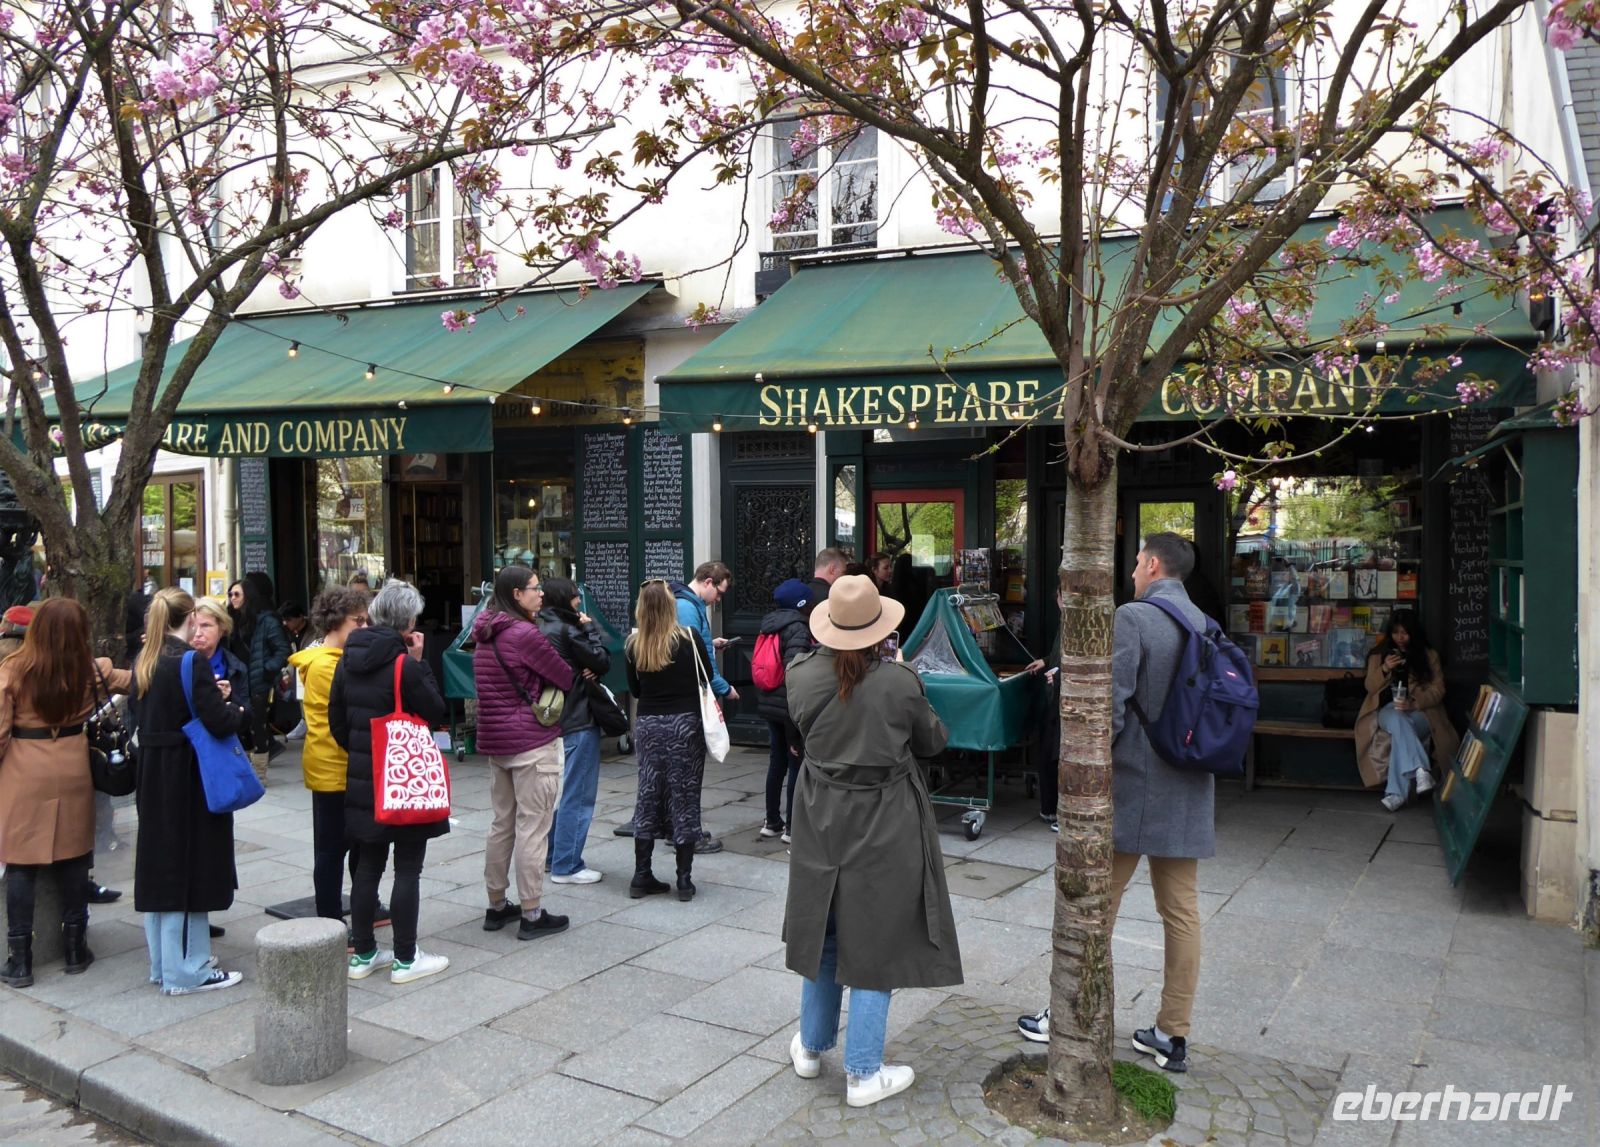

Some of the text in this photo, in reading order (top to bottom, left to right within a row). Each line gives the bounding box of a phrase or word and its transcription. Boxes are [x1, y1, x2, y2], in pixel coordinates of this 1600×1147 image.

[759, 380, 1040, 425] SHAKESPEARE
[1161, 362, 1387, 415] COMPANY
[218, 422, 271, 454] AND
[278, 417, 407, 452] COMPANY
[352, 503, 365, 513] YES
[1457, 570, 1485, 584] from
[1448, 582, 1464, 595] the
[1458, 599, 1483, 613] into
[1454, 615, 1483, 629] your
